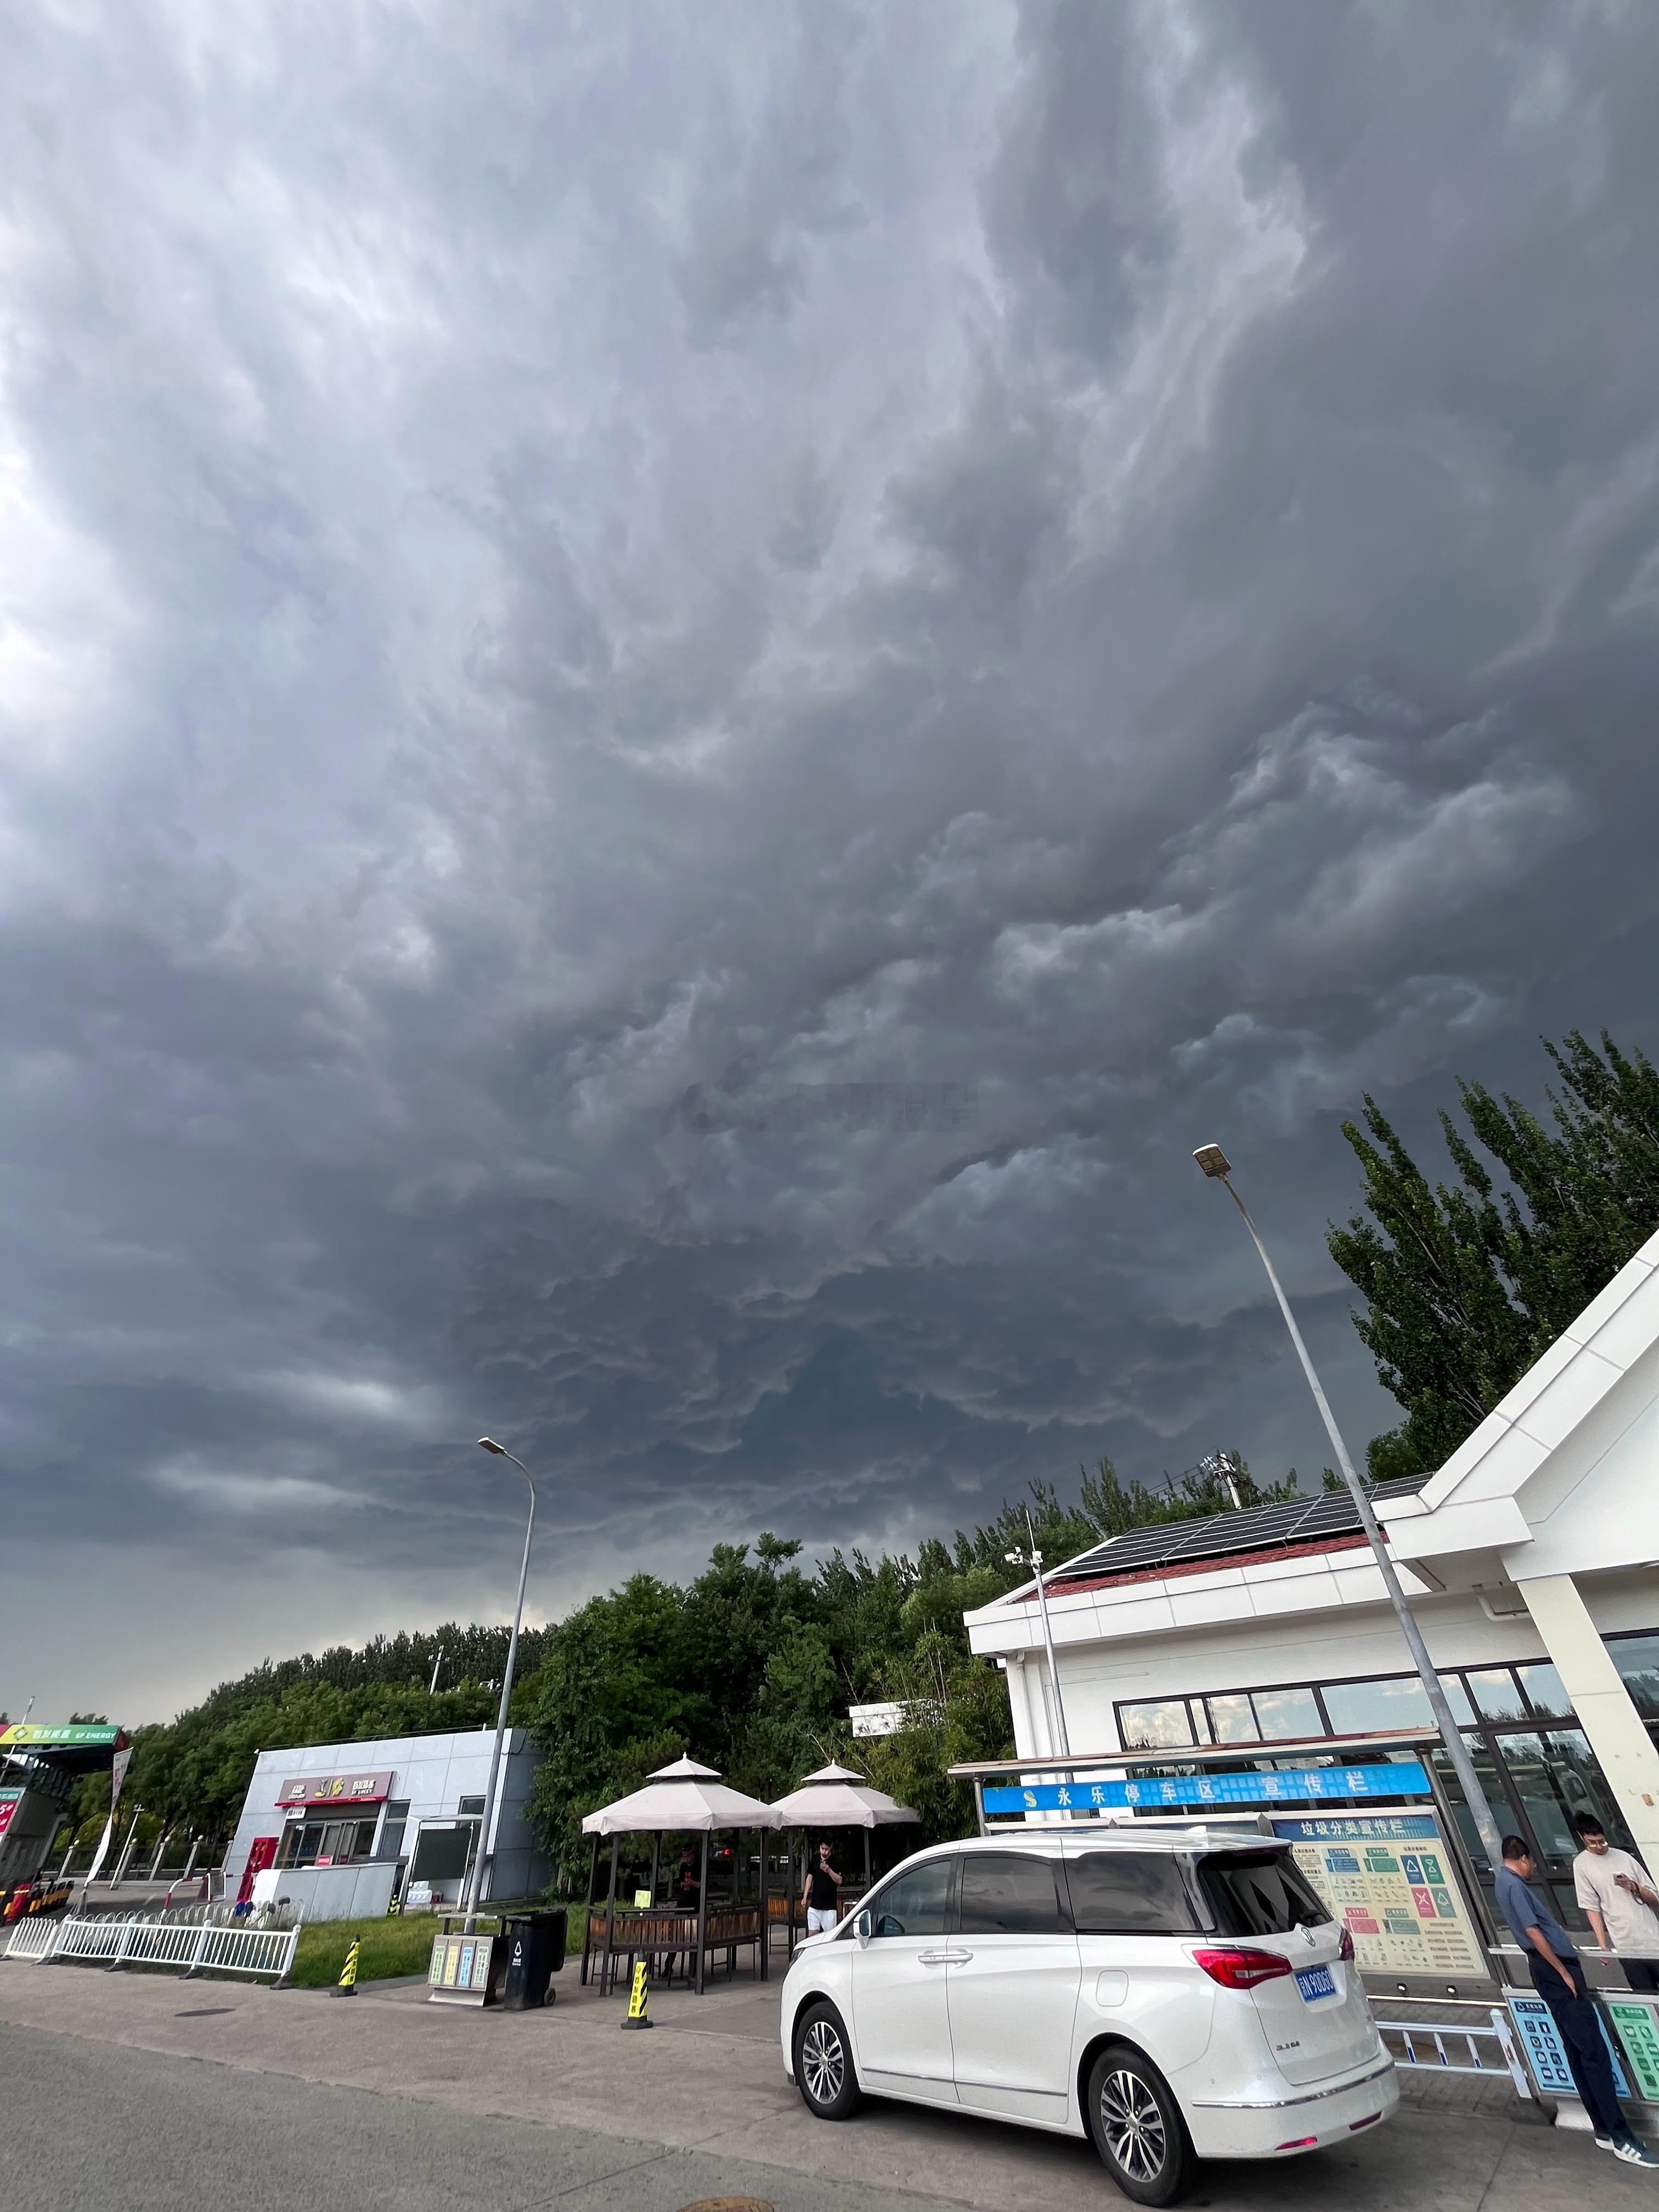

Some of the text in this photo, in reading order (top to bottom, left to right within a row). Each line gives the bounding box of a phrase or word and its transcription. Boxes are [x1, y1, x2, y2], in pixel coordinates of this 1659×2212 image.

[1057, 1780, 1216, 1807] 永乐停车区
[1262, 1771, 1368, 1796] 宣传栏
[1300, 1819, 1406, 1836] 垃圾分类宣传栏
